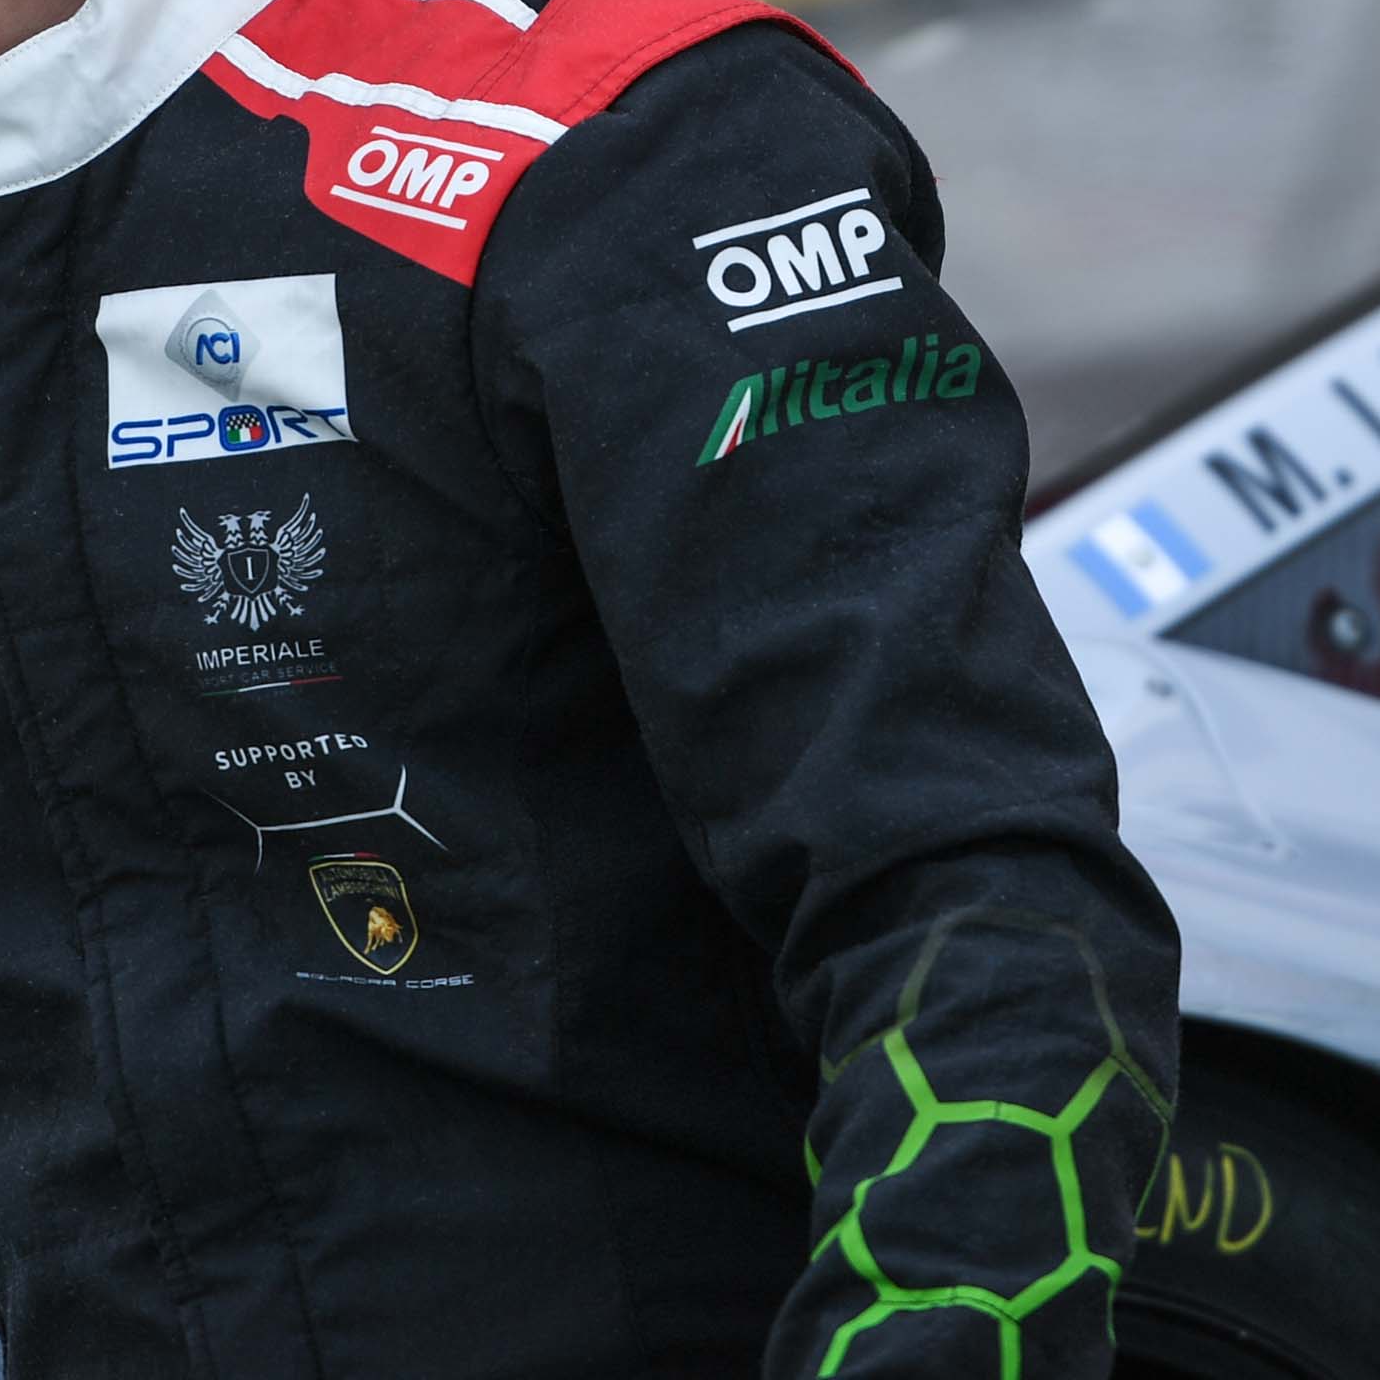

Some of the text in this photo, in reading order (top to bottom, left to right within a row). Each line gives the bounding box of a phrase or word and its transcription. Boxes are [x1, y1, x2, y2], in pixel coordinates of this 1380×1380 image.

[347, 139, 490, 209] OMP
[706, 208, 886, 308] OMP
[695, 333, 982, 468] Alitalia
[111, 404, 346, 463] SPORT
[1202, 426, 1356, 536] M.
[196, 639, 325, 671] IMPERIALE
[215, 733, 369, 770] SUPPORTED
[284, 769, 318, 790] BY
[406, 974, 475, 990] CORSE
